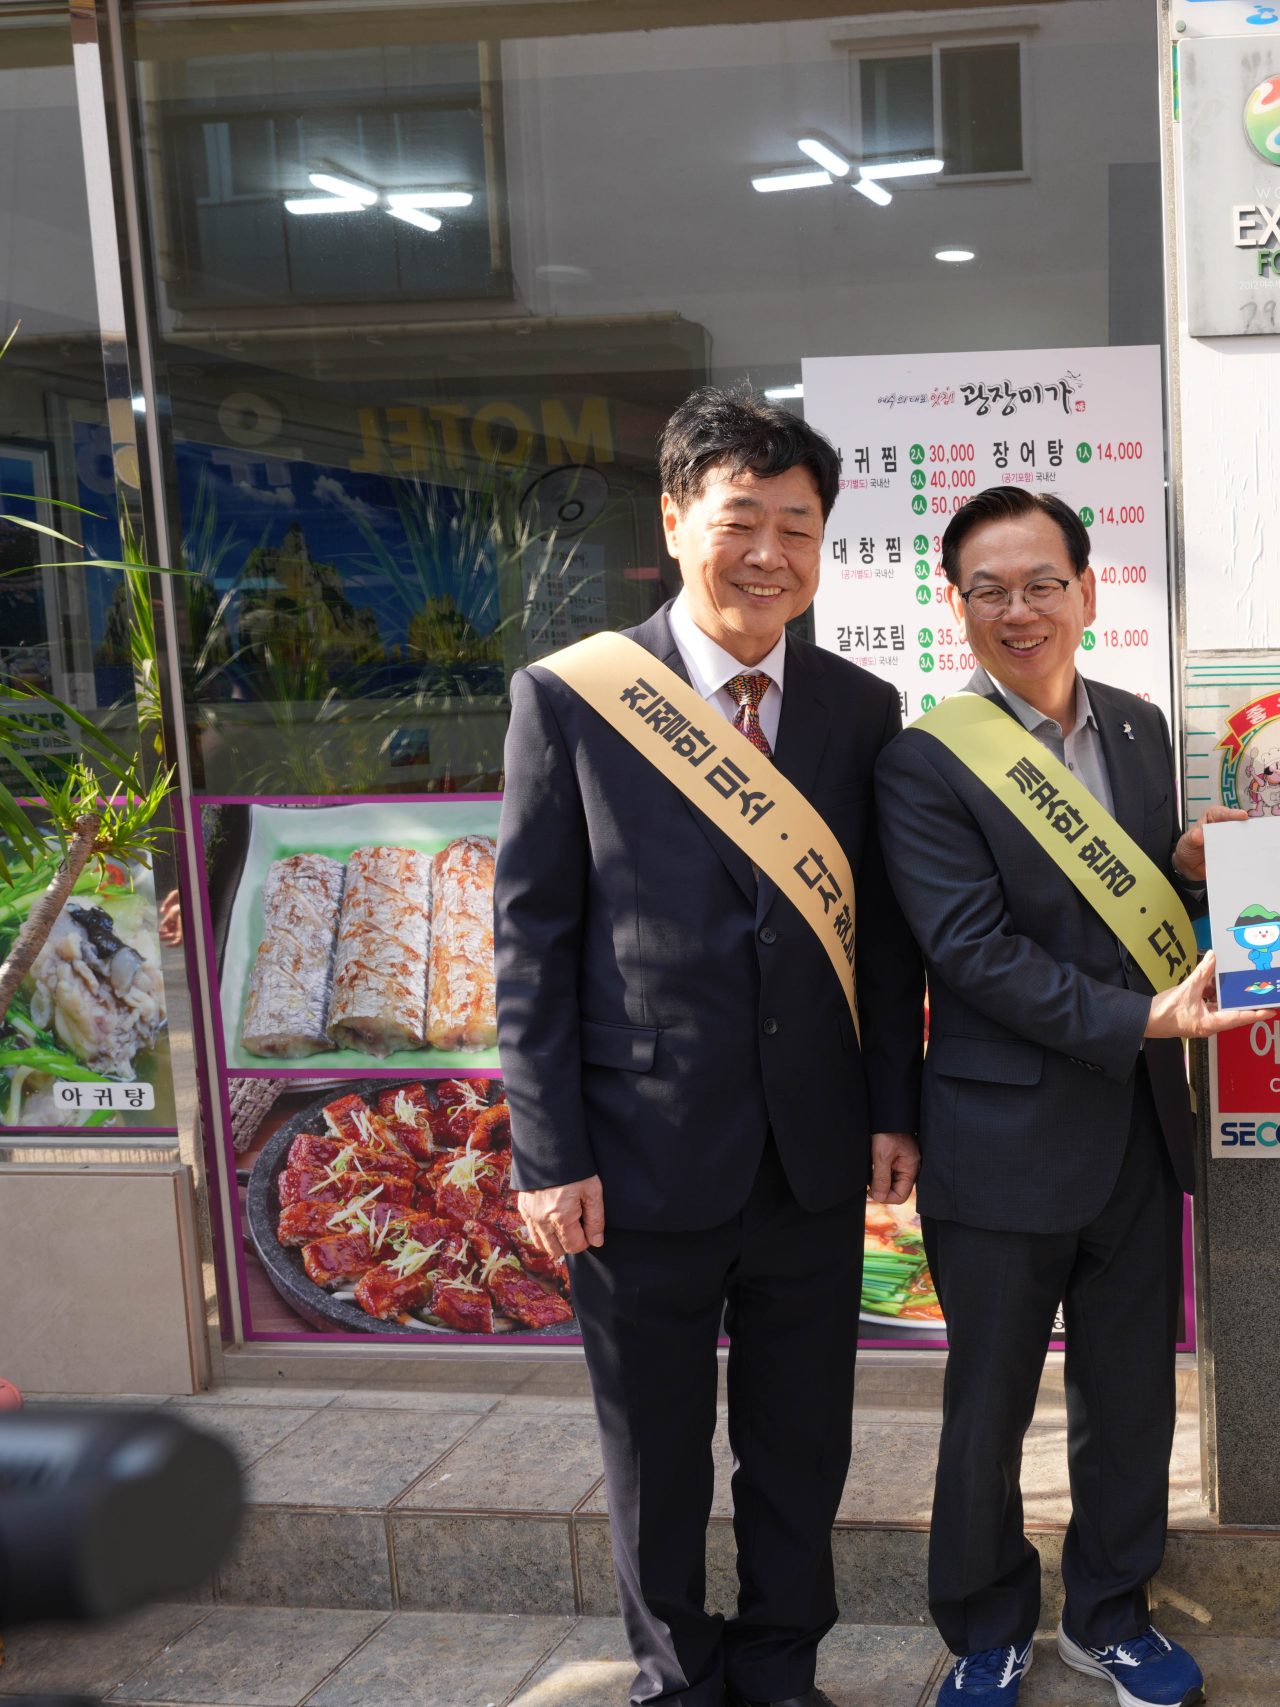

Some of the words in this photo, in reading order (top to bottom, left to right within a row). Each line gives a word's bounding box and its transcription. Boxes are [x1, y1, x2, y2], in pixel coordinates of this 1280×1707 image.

[959, 381, 1073, 417] 광장미가
[929, 444, 975, 463] 30,000
[993, 439, 1064, 468] 장어탕
[1097, 442, 1143, 462] 14,000
[839, 479, 868, 490] 공기별도)
[930, 470, 975, 489] 40,000
[932, 496, 974, 515] 50,0
[1099, 505, 1145, 525] 14,000
[1100, 565, 1147, 586] 40,000
[836, 624, 905, 652] 갈치조림
[1103, 629, 1149, 649] 18,000
[939, 653, 979, 672] 55,00
[619, 677, 718, 768] 친절한
[704, 756, 775, 825] 미소
[792, 847, 843, 914] 다시
[1004, 756, 1089, 844] 깨끗한
[1077, 835, 1137, 898] 환경
[1147, 919, 1187, 978] 다시
[60, 1085, 147, 1107] 아귀탕
